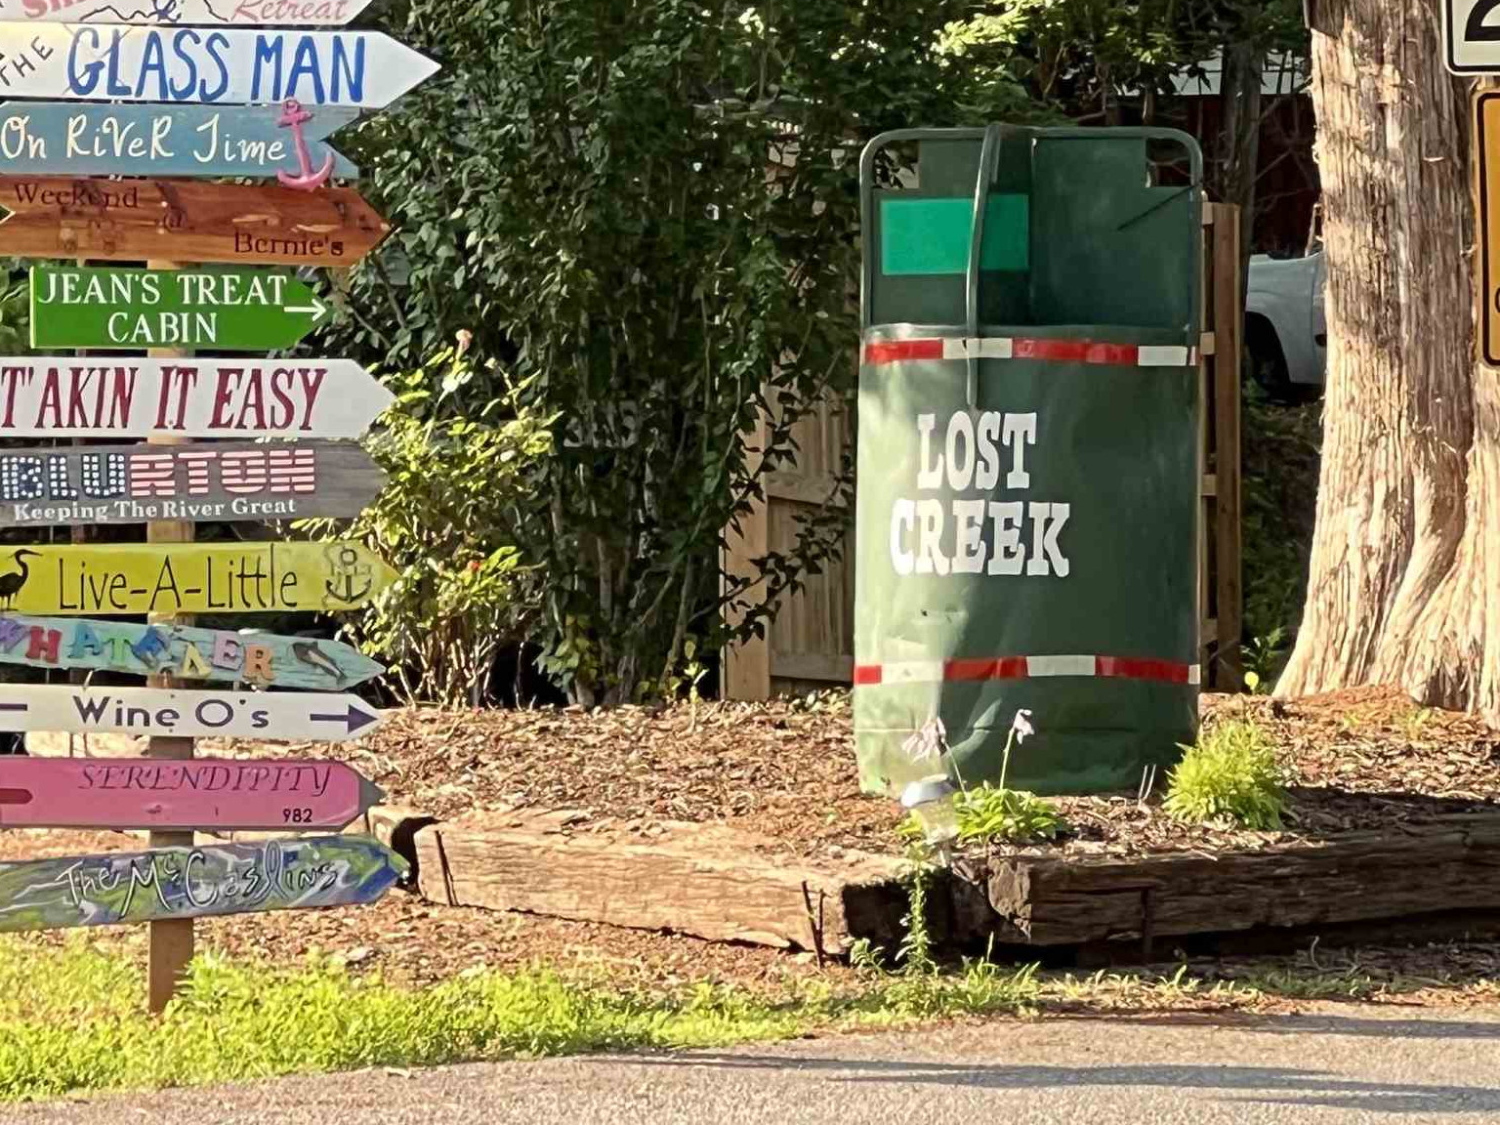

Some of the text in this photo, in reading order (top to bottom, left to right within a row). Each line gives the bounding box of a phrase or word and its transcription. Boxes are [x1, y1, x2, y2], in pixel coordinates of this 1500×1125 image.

[67, 28, 230, 100] GLASS
[252, 34, 366, 104] MAN
[0, 115, 47, 160] On
[233, 231, 344, 256] Bernie's
[38, 273, 287, 305] JEAN'S TREAT
[107, 313, 217, 343] CABIN
[153, 365, 199, 429] IT
[208, 367, 327, 430] EASY
[917, 410, 1037, 491] LOST
[0, 449, 315, 501] BLURTON
[14, 498, 296, 521] Keeping The River Great
[890, 498, 1070, 576] CREEK
[59, 543, 298, 610] Live-A-Little
[73, 695, 269, 729] Wine O's
[78, 765, 332, 798] SERENDIPITY
[282, 808, 313, 823] 982
[55, 861, 121, 908] The
